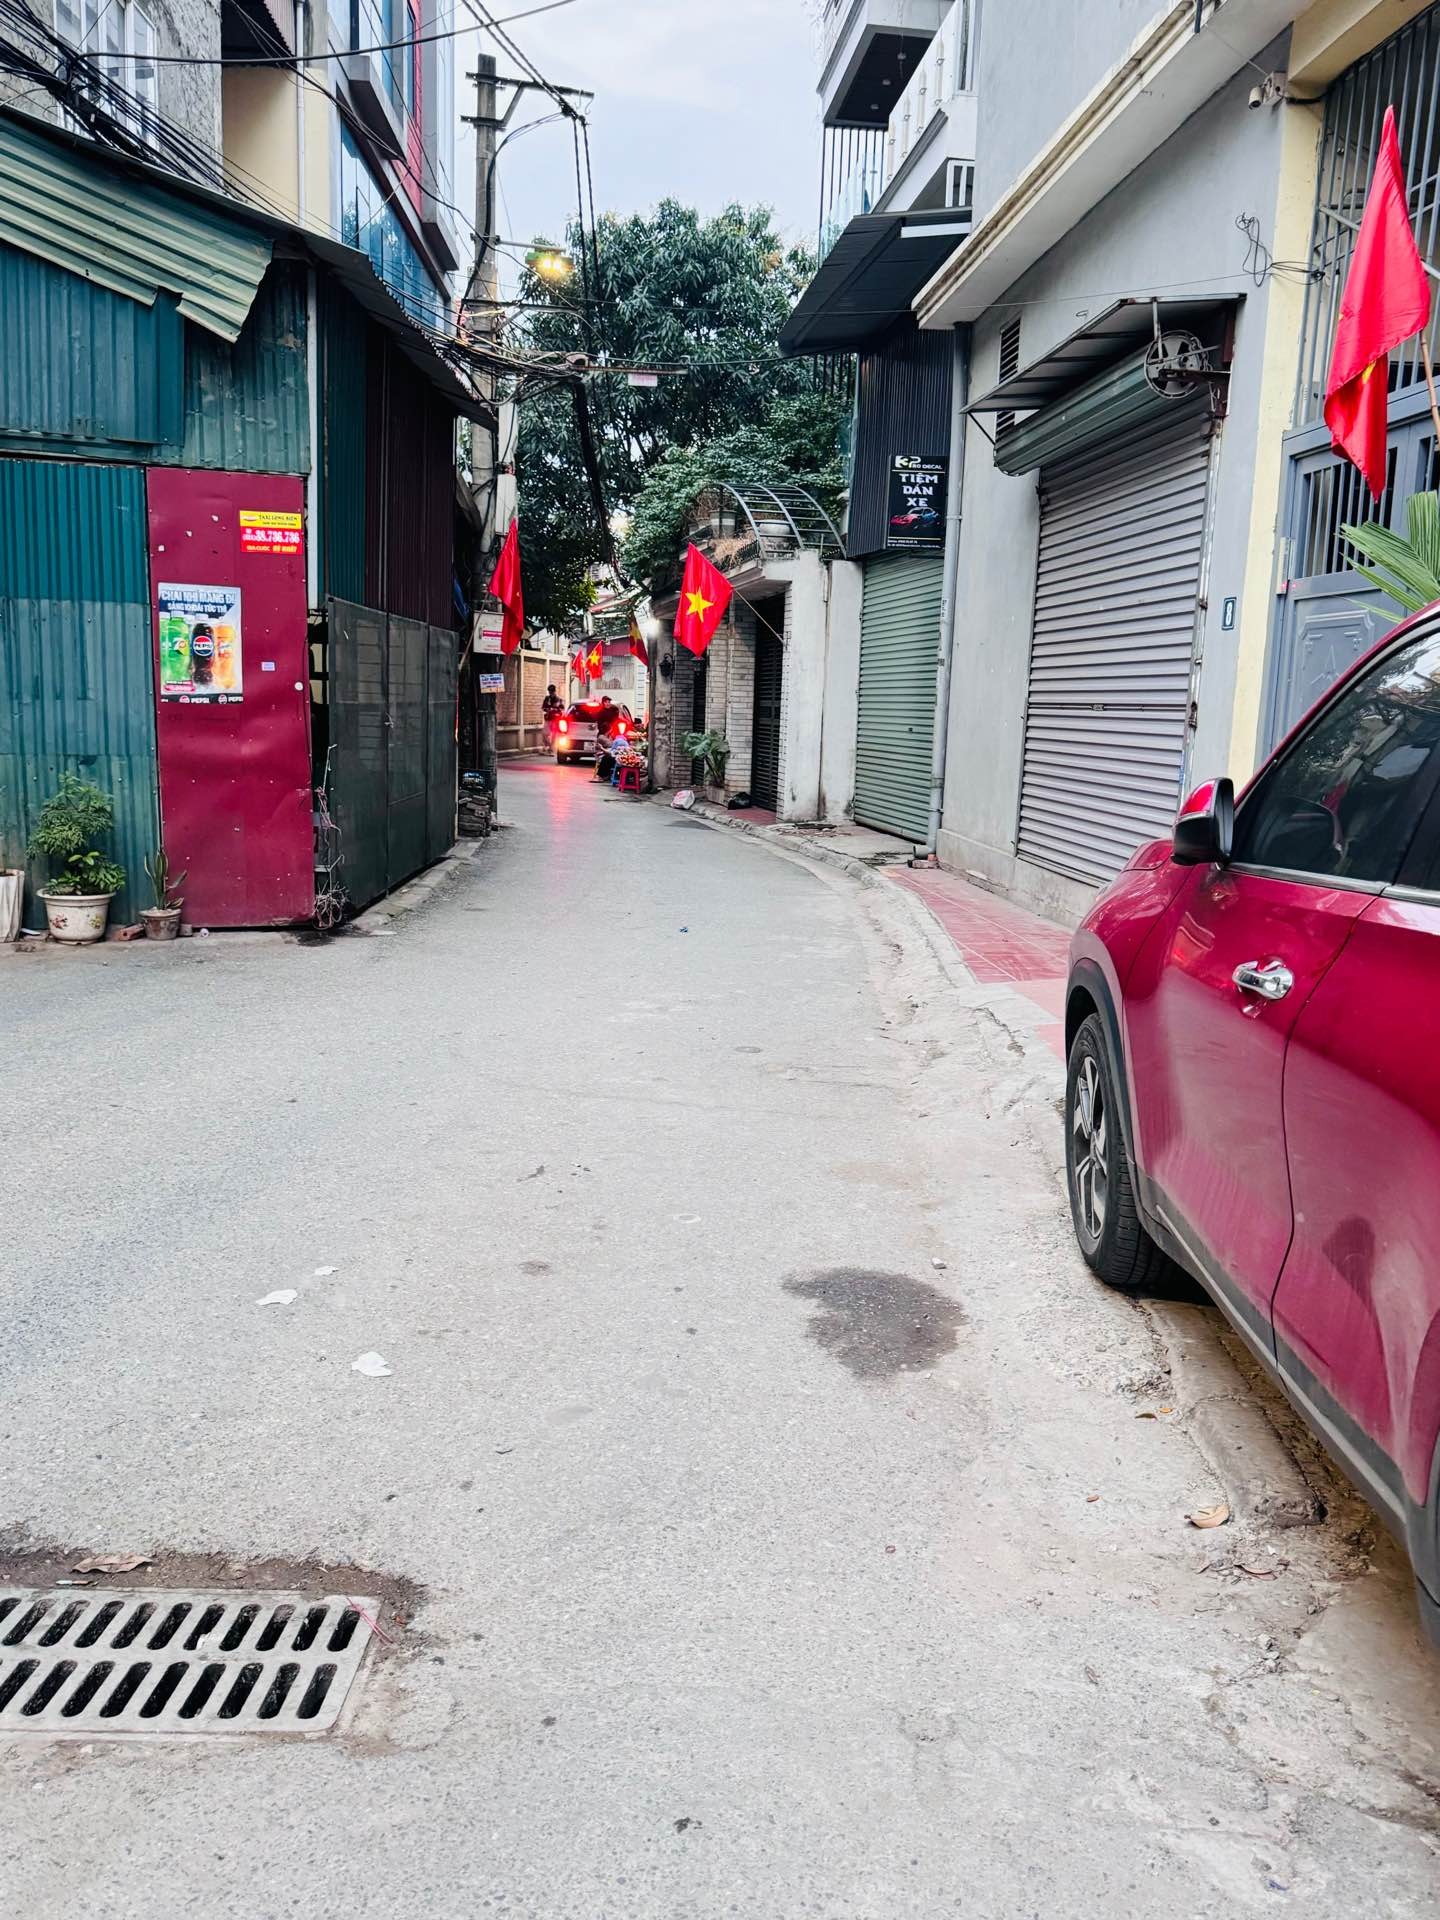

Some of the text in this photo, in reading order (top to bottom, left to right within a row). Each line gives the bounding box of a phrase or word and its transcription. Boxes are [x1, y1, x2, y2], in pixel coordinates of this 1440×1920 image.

[899, 473, 938, 484] TIỆM
[903, 484, 933, 495] DÁN
[907, 498, 928, 506] XE
[161, 590, 183, 601] CHAI
[1225, 601, 1233, 626] 8
